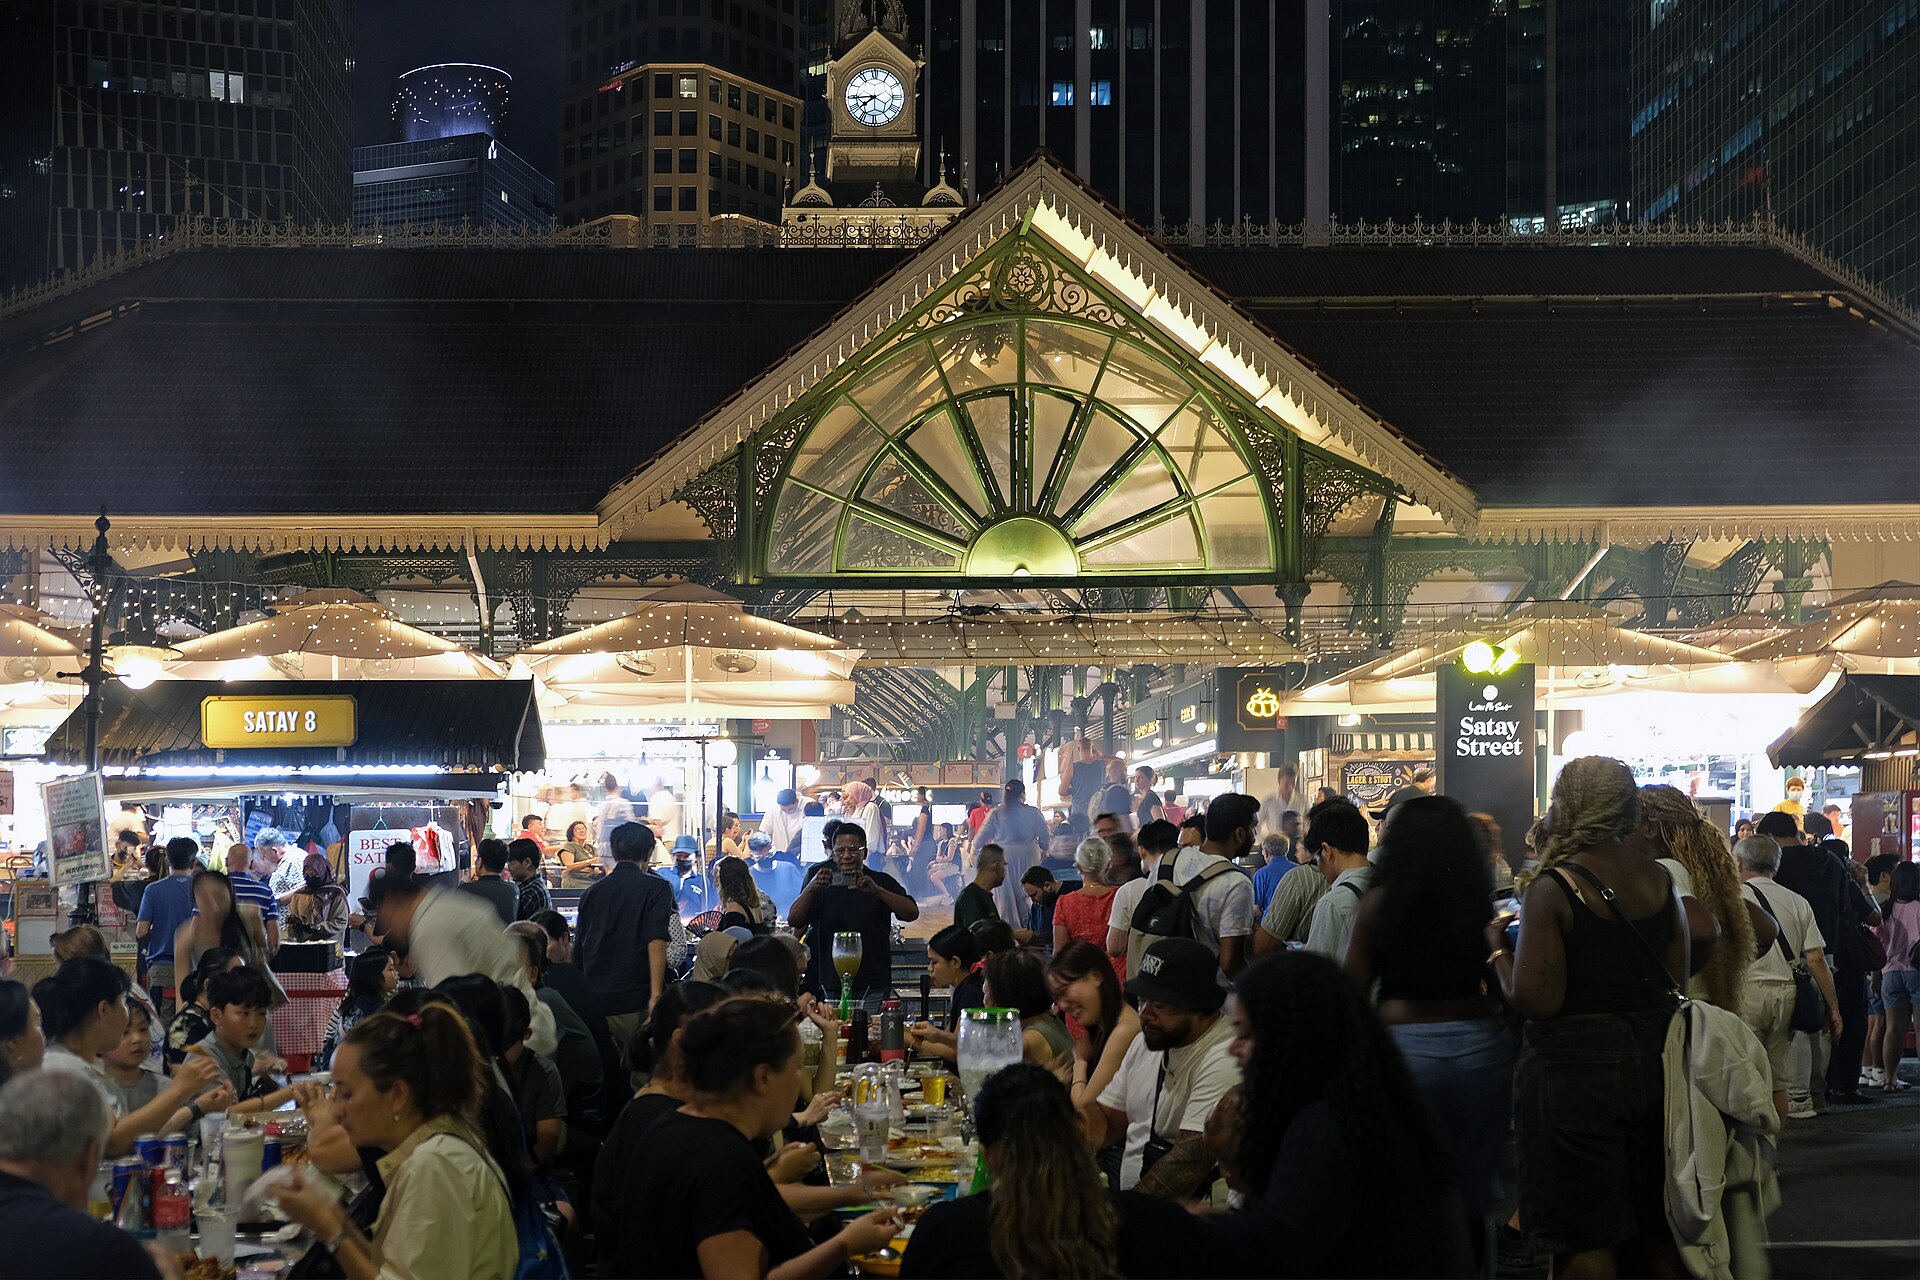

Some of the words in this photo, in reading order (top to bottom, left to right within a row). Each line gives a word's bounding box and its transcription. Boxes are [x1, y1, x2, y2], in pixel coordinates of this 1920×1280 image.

[243, 710, 299, 733] SATAY
[304, 710, 317, 733] 8
[1460, 716, 1520, 740] Satay
[1456, 737, 1524, 757] Street
[1346, 775, 1367, 785] LAGER
[1373, 775, 1393, 785] STOUT
[354, 852, 387, 865] SAT
